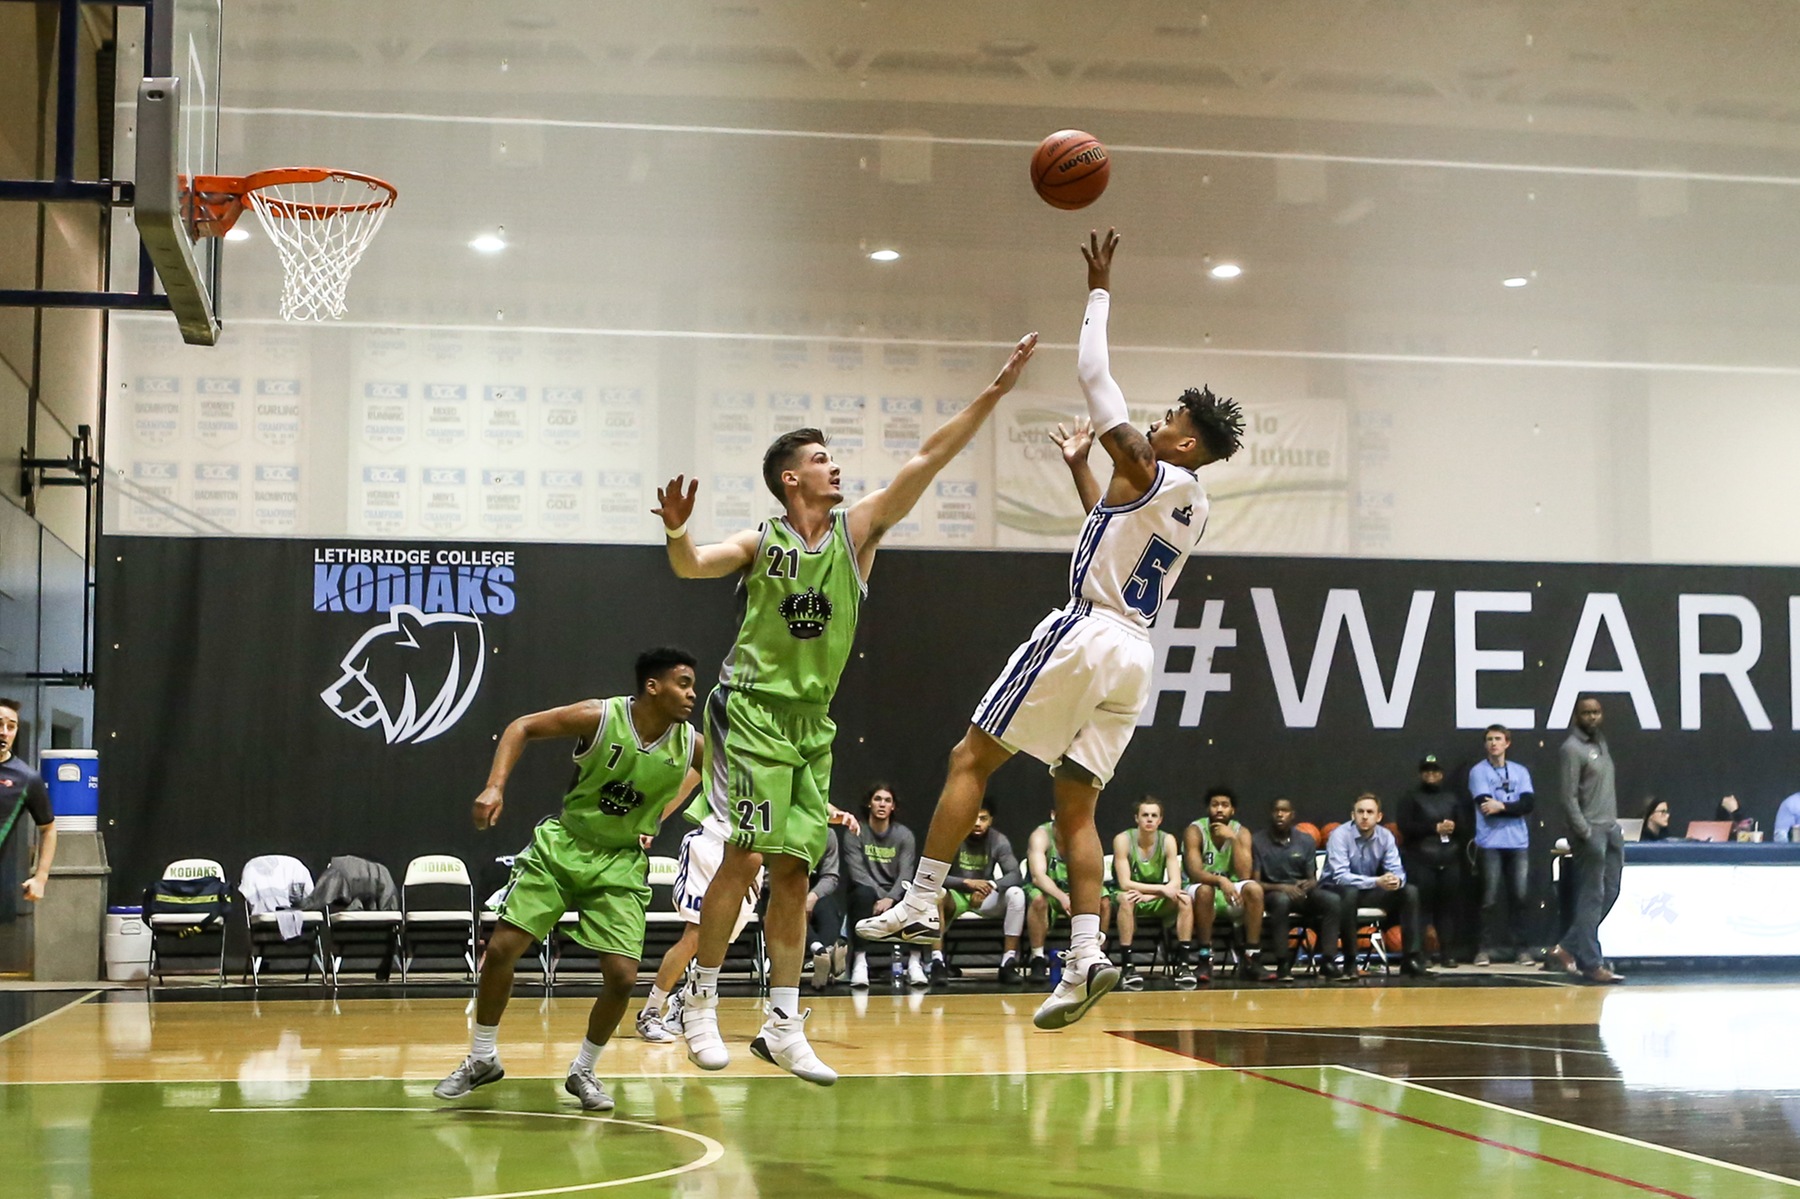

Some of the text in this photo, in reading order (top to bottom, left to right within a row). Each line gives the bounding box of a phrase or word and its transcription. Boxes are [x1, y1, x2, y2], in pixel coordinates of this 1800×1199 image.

[1058, 146, 1105, 173] Wilson
[257, 405, 299, 416] CURLING
[547, 415, 578, 425] GOLF
[546, 499, 577, 509] GOLF
[314, 548, 515, 566] LETHBRIDGE COLLEGE
[767, 545, 799, 580] 21
[313, 563, 516, 615] KODIAKS
[1121, 532, 1182, 619] 5
[1136, 588, 1800, 731] #WEAR
[605, 743, 624, 770] 7
[736, 798, 772, 833] 21
[170, 866, 217, 878] KODIAKS
